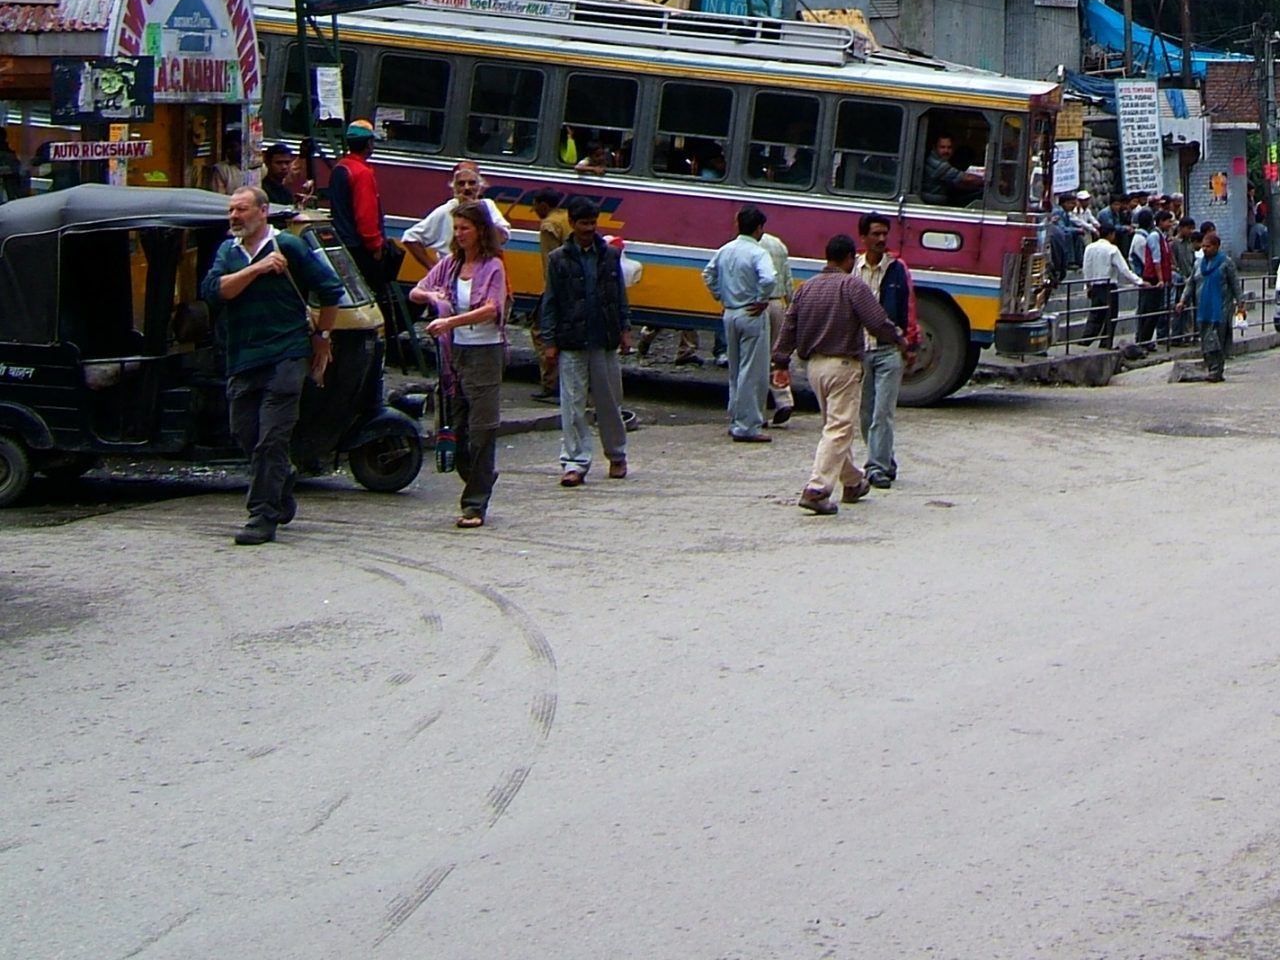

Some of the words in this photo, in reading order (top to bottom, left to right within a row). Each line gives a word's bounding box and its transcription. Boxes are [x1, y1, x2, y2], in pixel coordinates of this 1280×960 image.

[182, 57, 230, 93] MARK
[53, 144, 80, 159] AUTO
[82, 142, 148, 158] RICKSHAW
